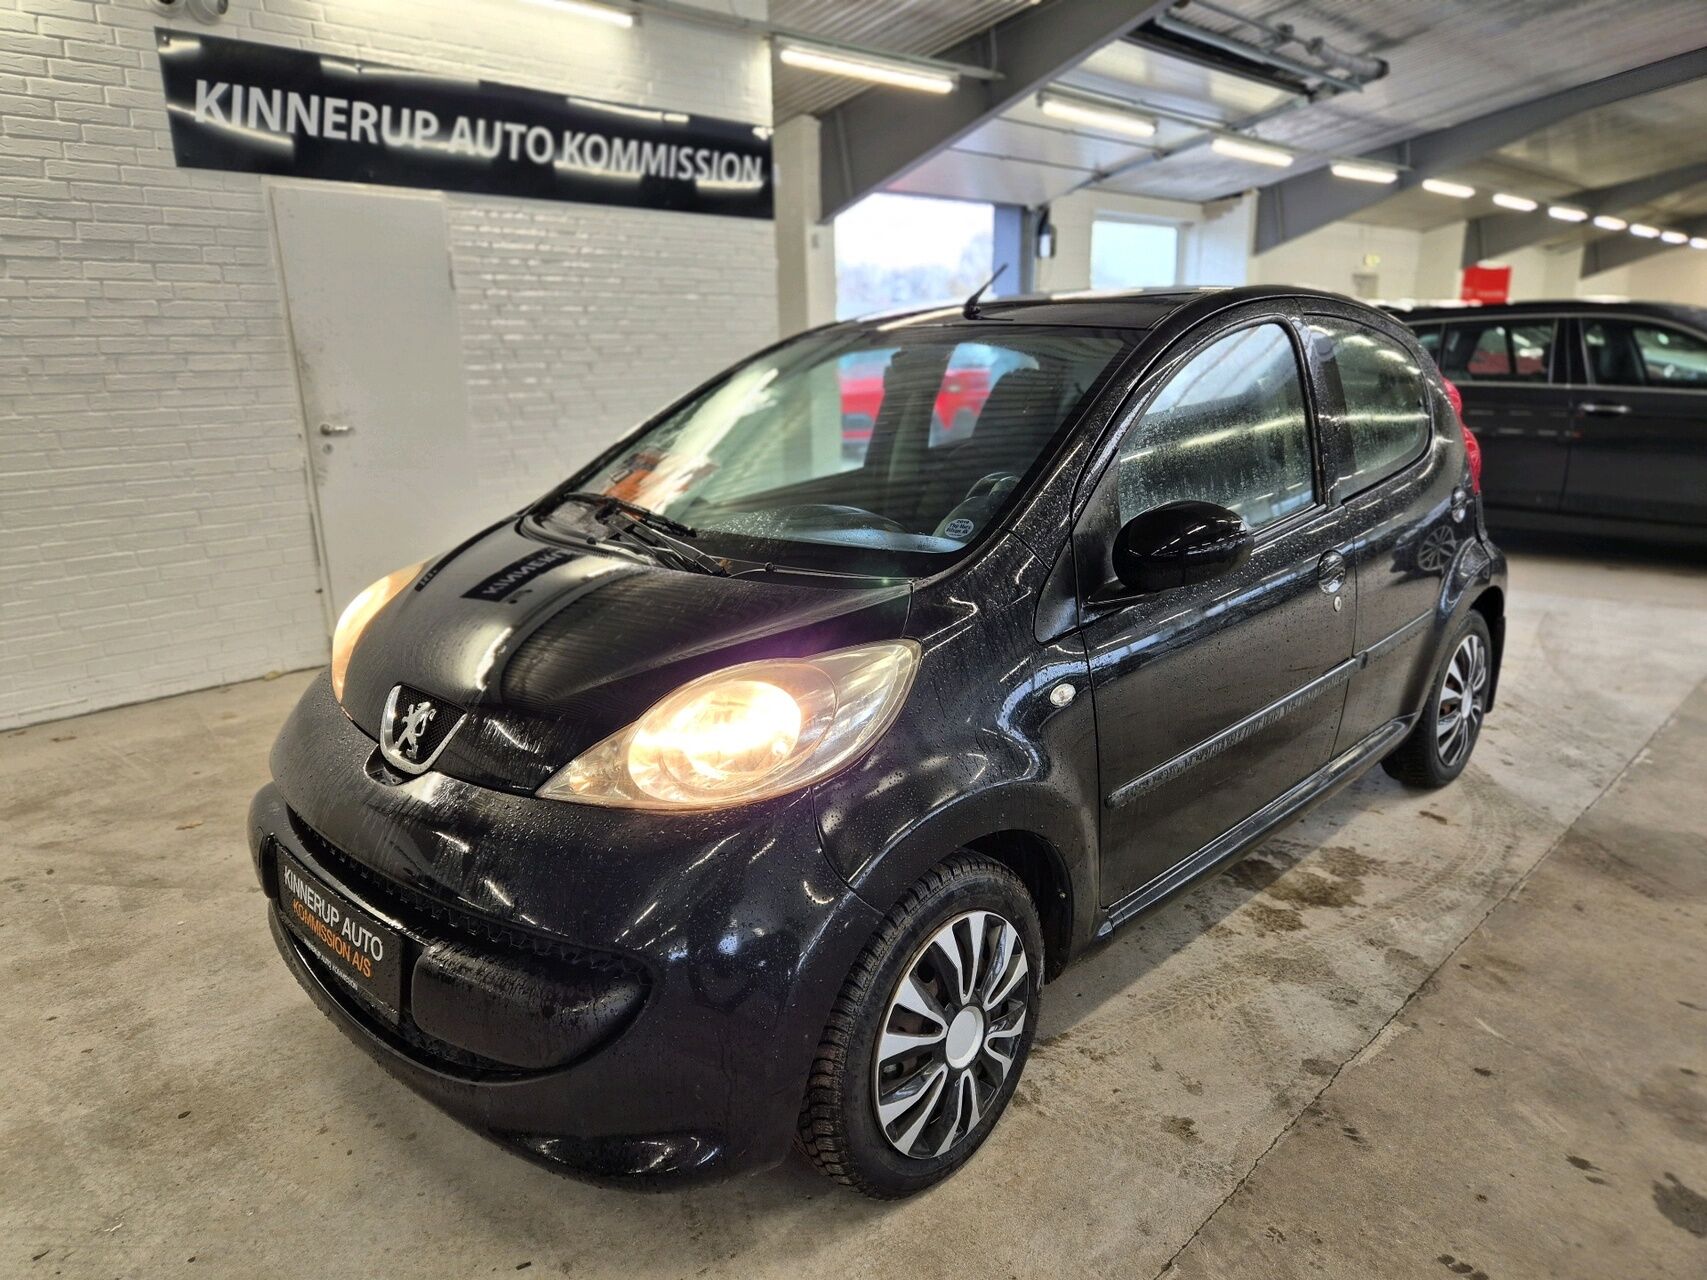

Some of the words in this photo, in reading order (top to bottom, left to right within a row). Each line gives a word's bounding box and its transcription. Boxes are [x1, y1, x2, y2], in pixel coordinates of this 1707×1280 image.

[194, 79, 439, 148] KINNERUP
[447, 116, 556, 164] AUTO
[562, 131, 763, 183] KOMMISSION
[284, 866, 340, 927] KINNERUP
[341, 917, 383, 962] AUTO
[293, 899, 350, 962] KOMMISSION
[352, 951, 372, 978] A/S
